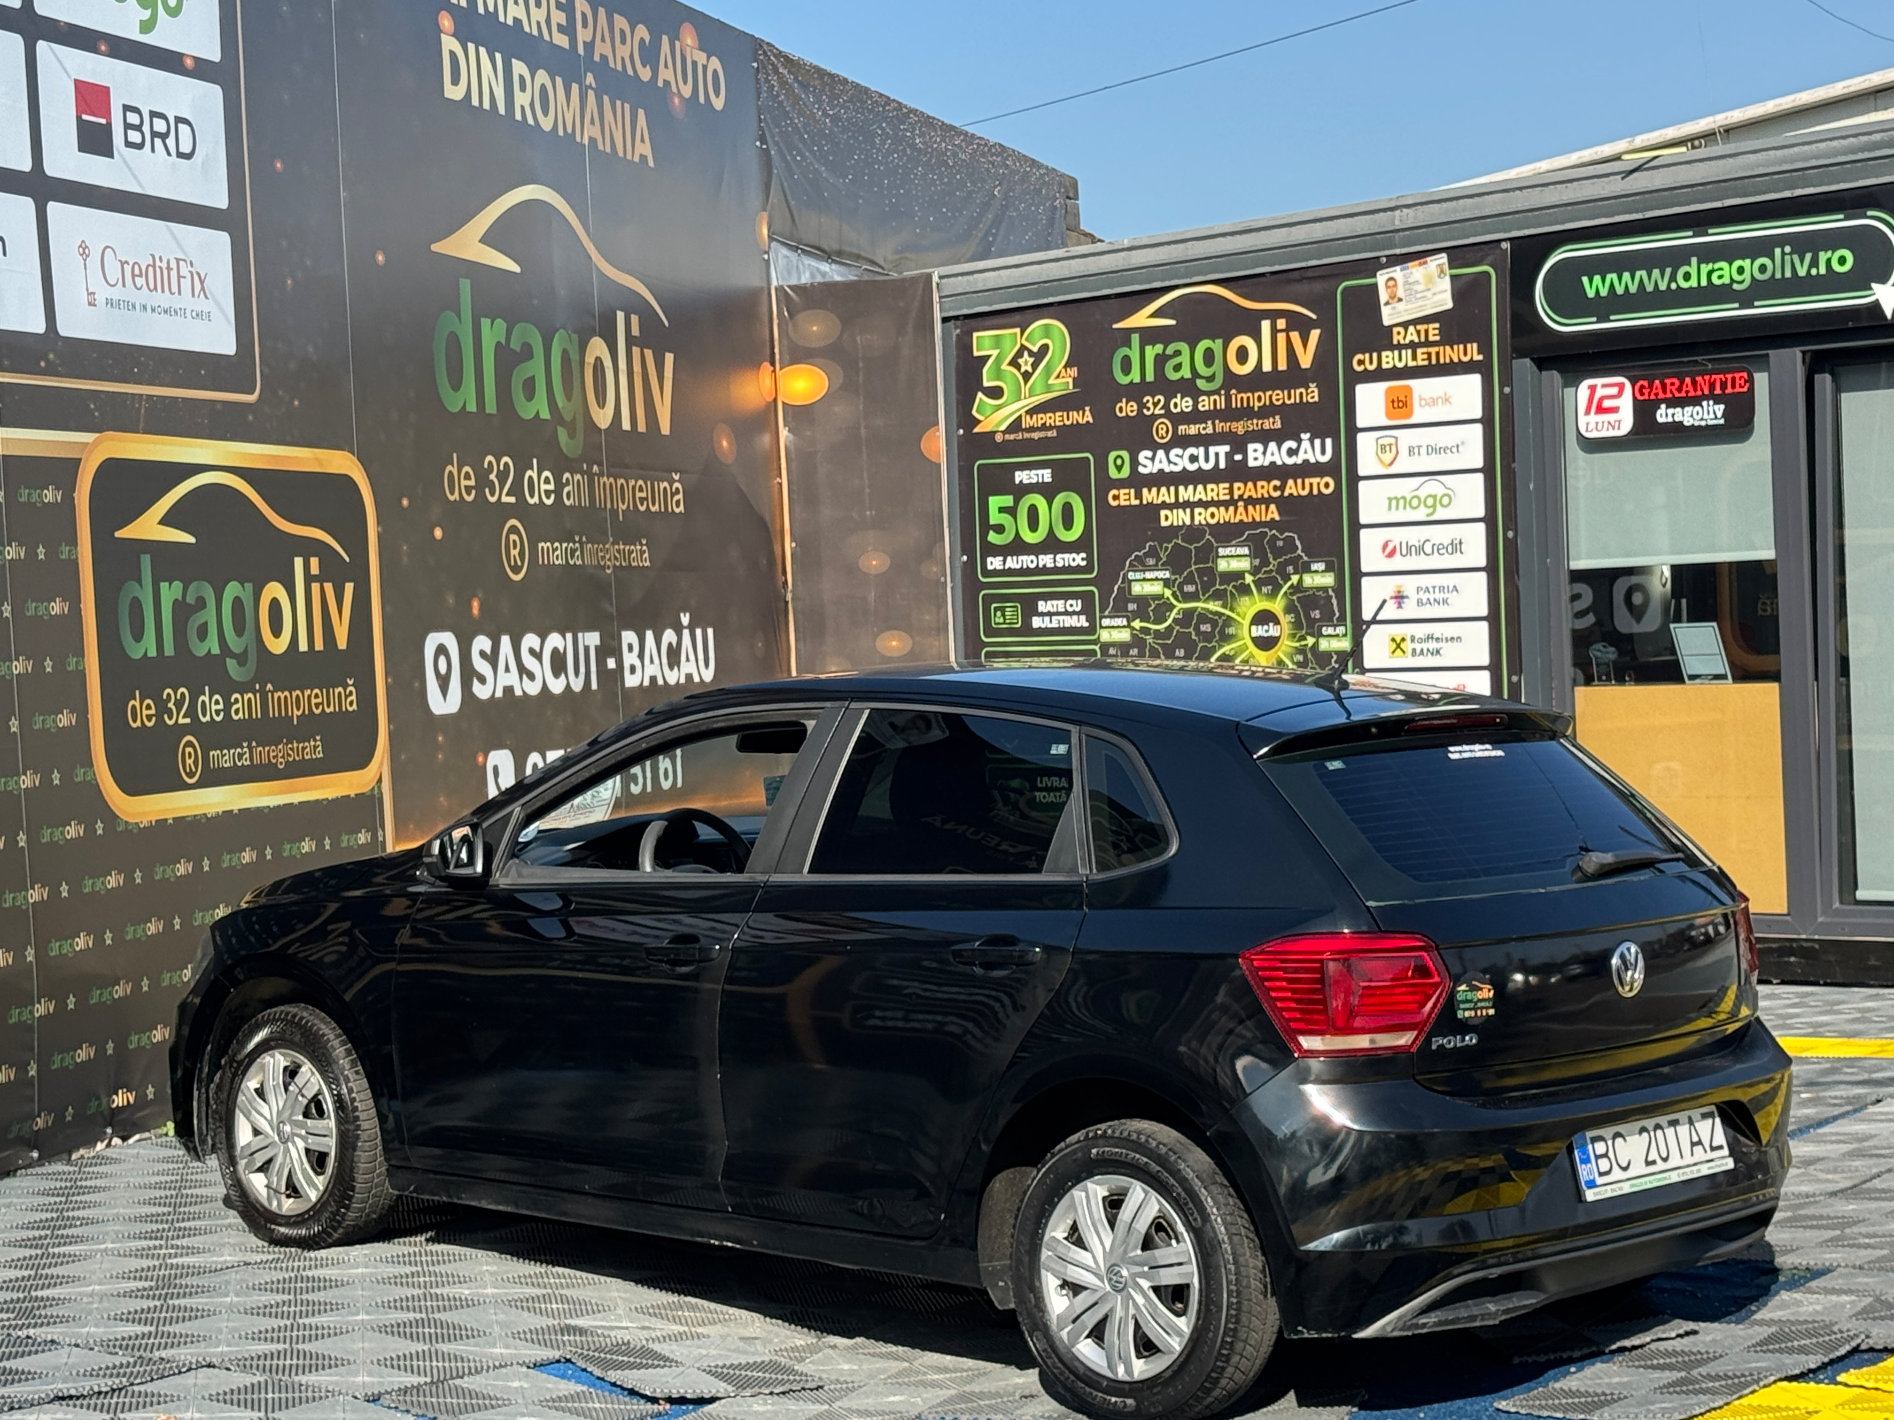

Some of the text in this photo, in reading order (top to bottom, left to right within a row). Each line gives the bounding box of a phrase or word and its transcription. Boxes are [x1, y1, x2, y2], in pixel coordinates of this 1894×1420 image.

[575, 0, 652, 83] PARC
[657, 34, 726, 112] AUTO
[440, 33, 655, 168] DIN ROMÂNIA
[122, 103, 197, 161] BRD
[100, 245, 210, 300] CreditFix
[1581, 245, 1854, 298] www.dragoliv.ro
[105, 297, 212, 322] PRIETEN IN MOMENTE CHEIE
[1392, 323, 1440, 345] RATE
[1112, 318, 1322, 391] dragoliv
[1352, 342, 1484, 372] CU BULETINUL
[433, 278, 675, 458] dragoliv
[971, 318, 1073, 421] 32
[1060, 366, 1078, 379] ANI
[1115, 382, 1320, 417] de 32 de ani împreună
[1389, 392, 1452, 411] tbi bank
[1584, 371, 1750, 416] 12 GARANTIE
[1021, 405, 1094, 429] ÎMPREUNĂ
[1177, 419, 1214, 436] marcă
[1214, 415, 1282, 435] înregistrată
[1585, 419, 1623, 433] LUNI
[1655, 399, 1725, 427] dragoliv
[1137, 444, 1231, 474] SASCUT
[1247, 433, 1333, 467] BACĂU
[1379, 442, 1394, 455] BT
[1408, 445, 1423, 457] BT
[444, 452, 685, 521] de 32 de ani împreună
[1014, 468, 1053, 485] PESTE
[17, 485, 63, 506] dragoliv
[1107, 476, 1336, 507] CEL MAI MARE PARC AUTO
[1386, 492, 1453, 517] mogo
[987, 491, 1086, 546] 500
[1159, 502, 1281, 527] DIN ROMÂNIA
[538, 535, 582, 566] marcă
[583, 535, 651, 573] înregistrată
[986, 552, 1087, 570] DE AUTO PE STOC
[1217, 546, 1250, 556] SUCEAVA
[1399, 538, 1464, 558] UniCredit
[1416, 584, 1459, 595] PATRIA
[1416, 597, 1450, 607] BANK
[25, 597, 70, 619] dragoliv
[118, 554, 354, 681] dragoliv
[1037, 598, 1082, 613] RATE CU
[1031, 614, 1090, 629] BULETINUL
[1250, 622, 1281, 638] BACĂU
[1410, 633, 1462, 644] Raiffeisen
[471, 633, 601, 700] SASCUT
[621, 612, 716, 688] BACĂU
[1411, 647, 1443, 657] BANK
[127, 678, 357, 728] de 32 de ani împreună
[32, 709, 77, 732] dragoliv
[209, 742, 251, 769] marcă
[252, 735, 324, 769] înregistrată
[40, 820, 85, 844] dragoliv
[2, 828, 372, 909] dragoliv dragoliv dragoliv dragoliv dragoliv dragoliv
[48, 931, 94, 957] dragoliv
[124, 917, 164, 940] dragoliv
[8, 997, 56, 1024] dragoliv
[89, 980, 133, 1005] dragoliv
[51, 1043, 96, 1069] dragoliv
[127, 1024, 170, 1049] dragoliv
[1431, 1033, 1479, 1050] POLO
[1581, 1163, 1594, 1182] RO
[1590, 1131, 1631, 1177] BC
[1638, 1110, 1725, 1168] 20TAZ
